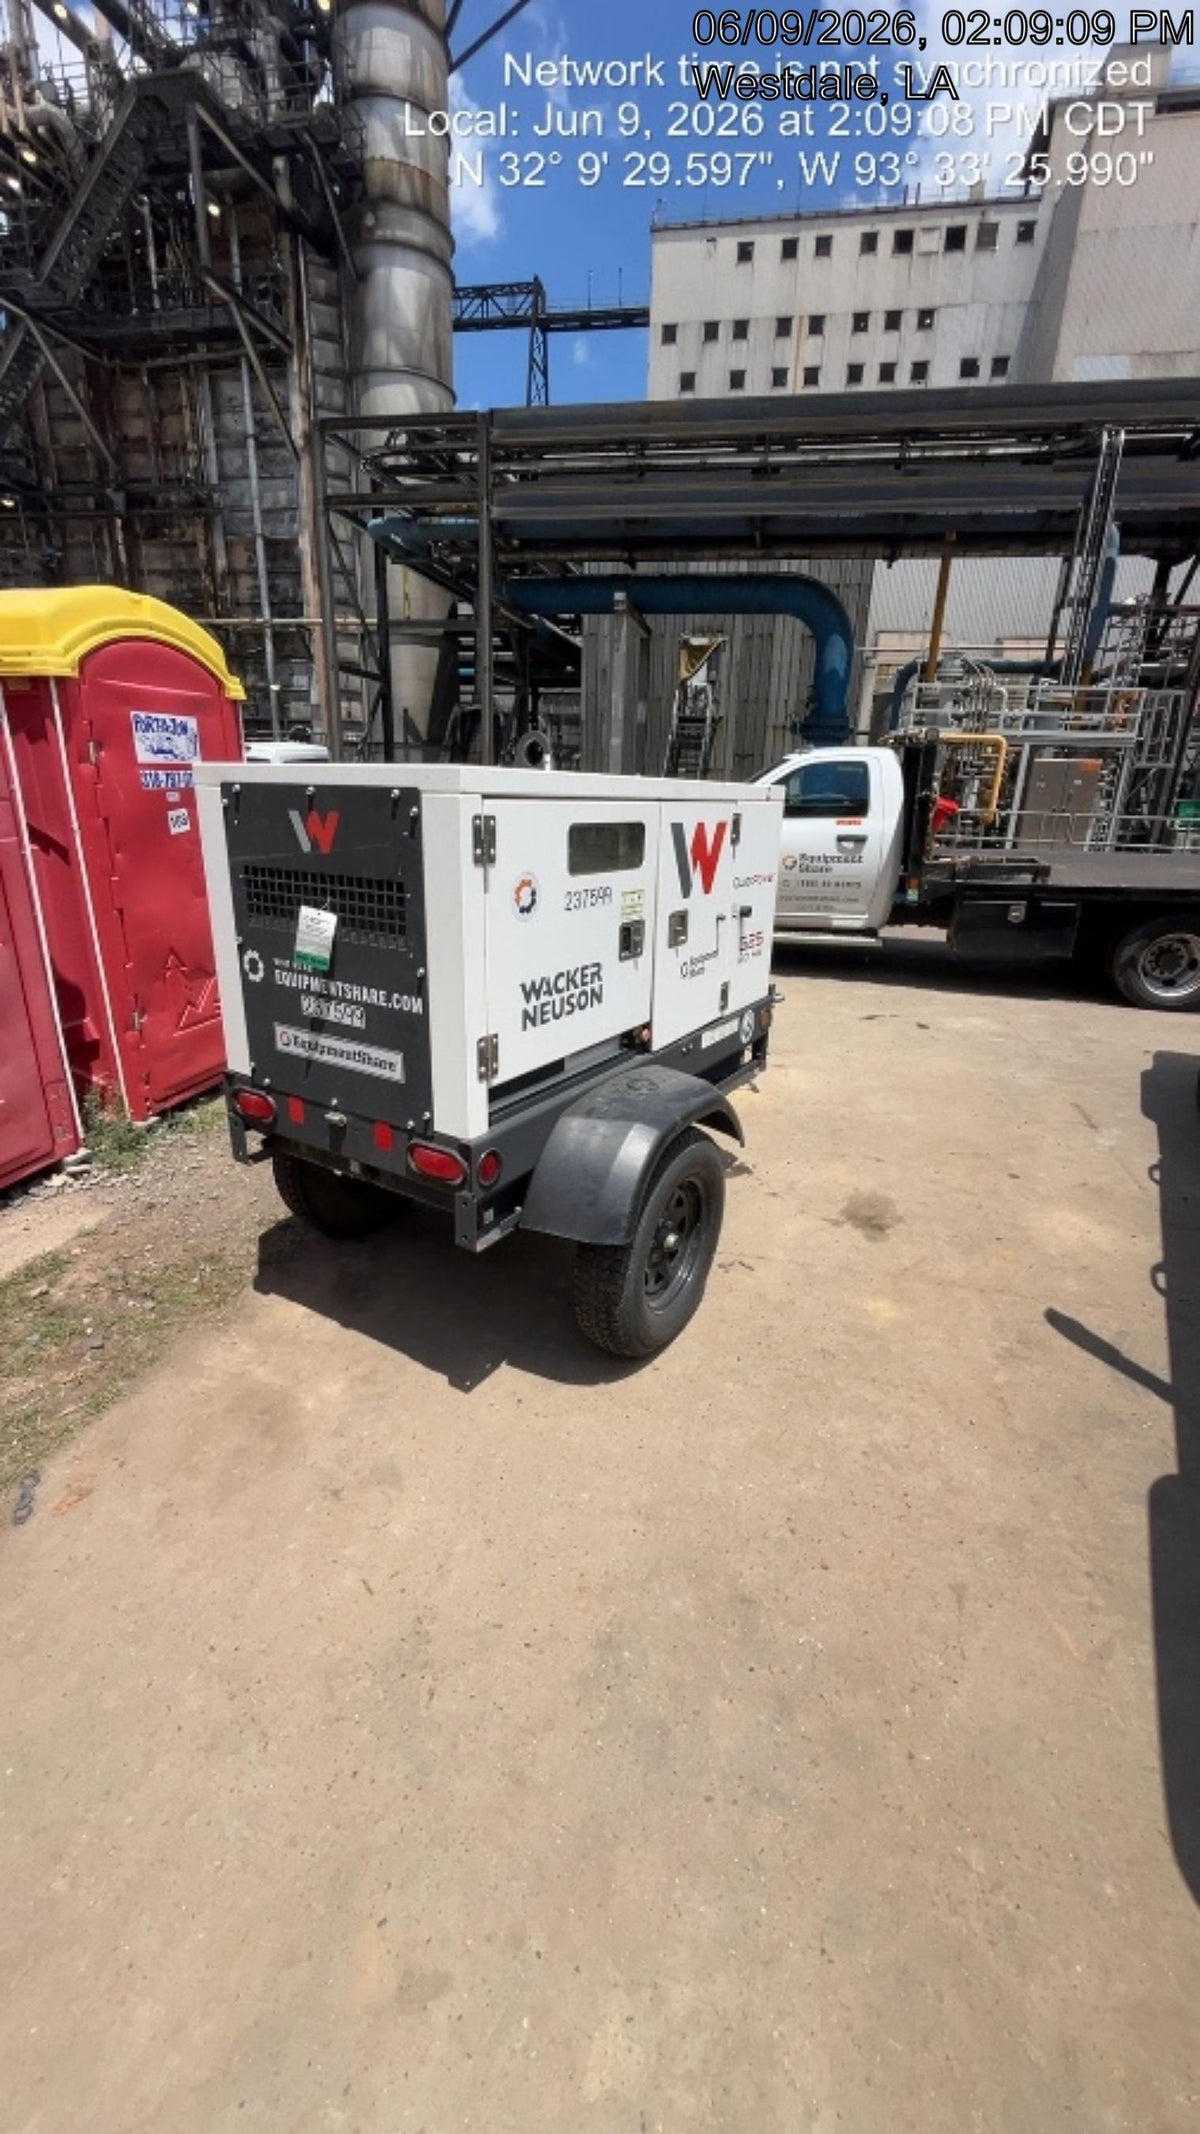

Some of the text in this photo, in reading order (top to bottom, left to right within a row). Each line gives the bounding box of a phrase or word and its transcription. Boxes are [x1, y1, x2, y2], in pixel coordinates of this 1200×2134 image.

[563, 886, 613, 912] 237599
[274, 969, 424, 1015] EQUIPMENTSHARE.COM
[519, 962, 603, 1005] WACKER
[521, 983, 603, 1032] NEUSON
[292, 1035, 398, 1073] EquipmentShare
